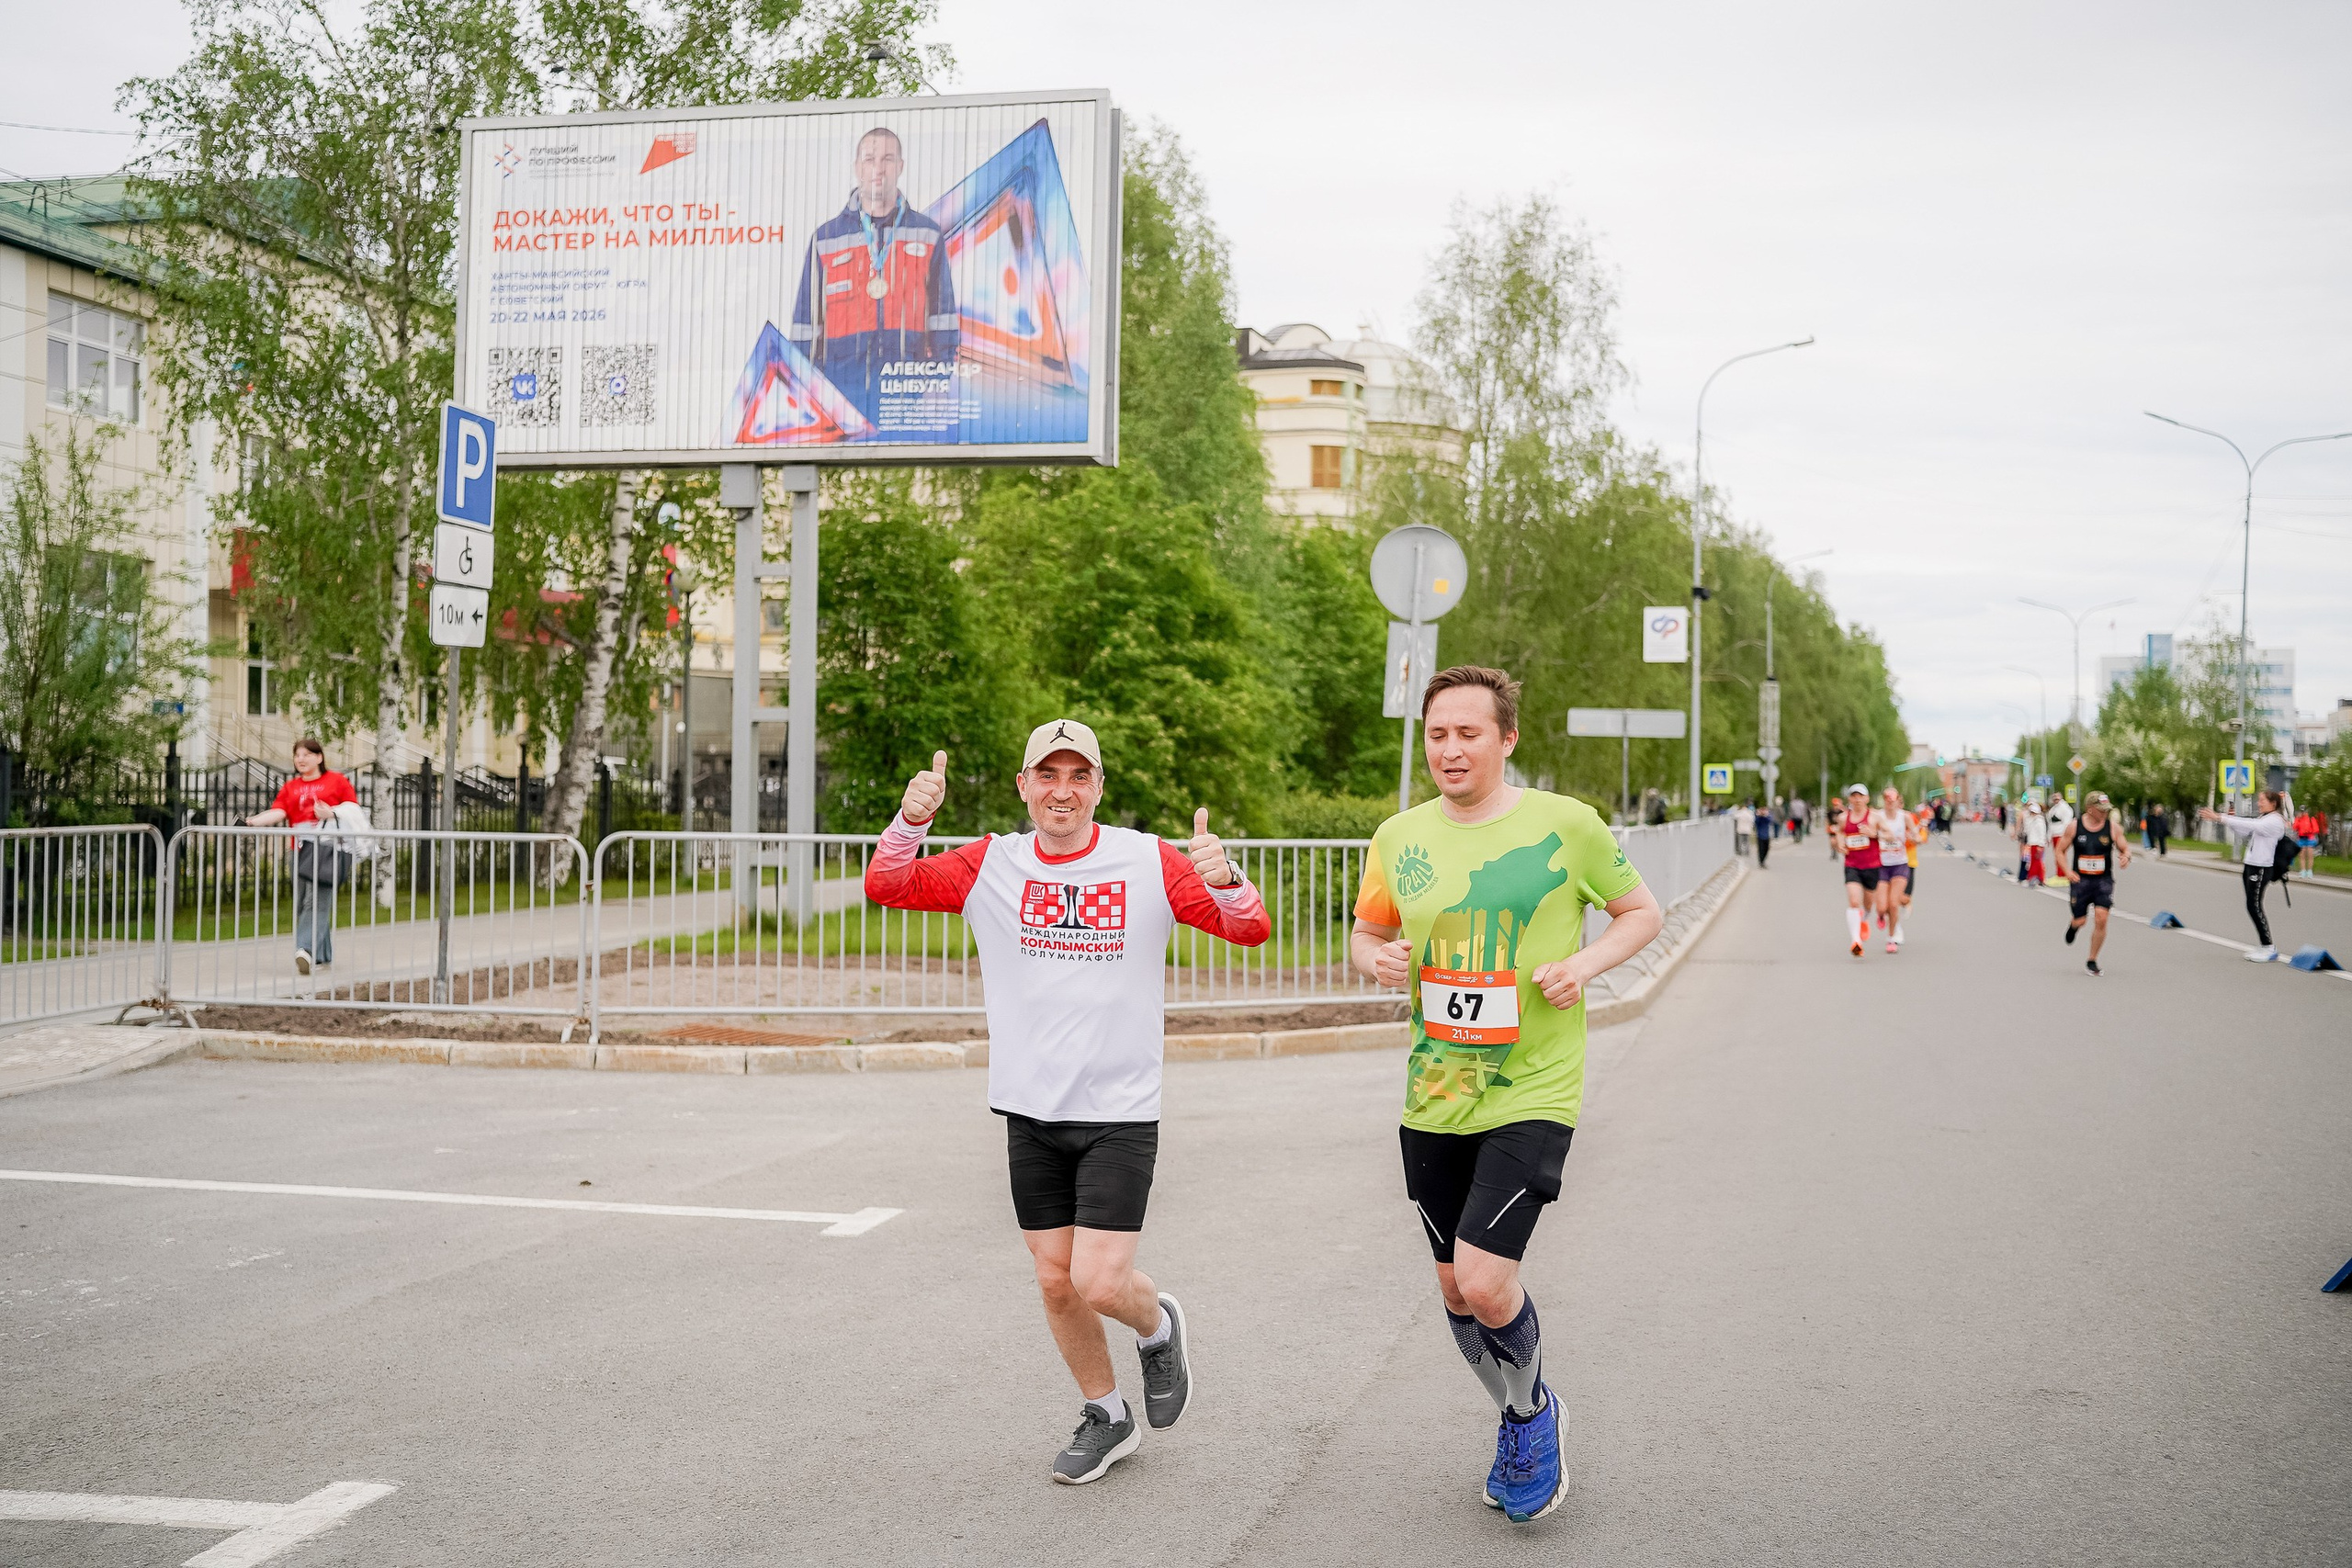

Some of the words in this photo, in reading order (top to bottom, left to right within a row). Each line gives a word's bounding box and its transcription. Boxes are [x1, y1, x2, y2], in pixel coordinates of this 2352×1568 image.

[493, 208, 616, 231] ДОКАЖИ,
[624, 204, 674, 222] ЧТО
[683, 202, 719, 221] ТЫ
[492, 232, 596, 253] МАСТЕР
[605, 231, 639, 249] НА
[649, 225, 785, 247] МИЛЛИОН
[491, 281, 570, 293] АВТОНОМНЫЙ
[572, 281, 606, 291] ОКРУГ
[616, 279, 648, 289] ЮГРА
[490, 311, 528, 323] 20-22
[533, 310, 566, 321] МАЯ
[571, 309, 606, 321] 2026
[880, 361, 982, 378] АЛЕКСАНДР
[880, 378, 950, 395] ЦЫБУЛЯ
[456, 417, 488, 509] P
[1397, 863, 1433, 896] TRAIL
[1021, 926, 1125, 942] МЕЖДУНАРОДНЫЙ
[1020, 936, 1125, 953] КОГАЛЫМСКИЙ
[1021, 947, 1124, 962] ПОЛУМАРАФОН
[1447, 992, 1484, 1021] 67
